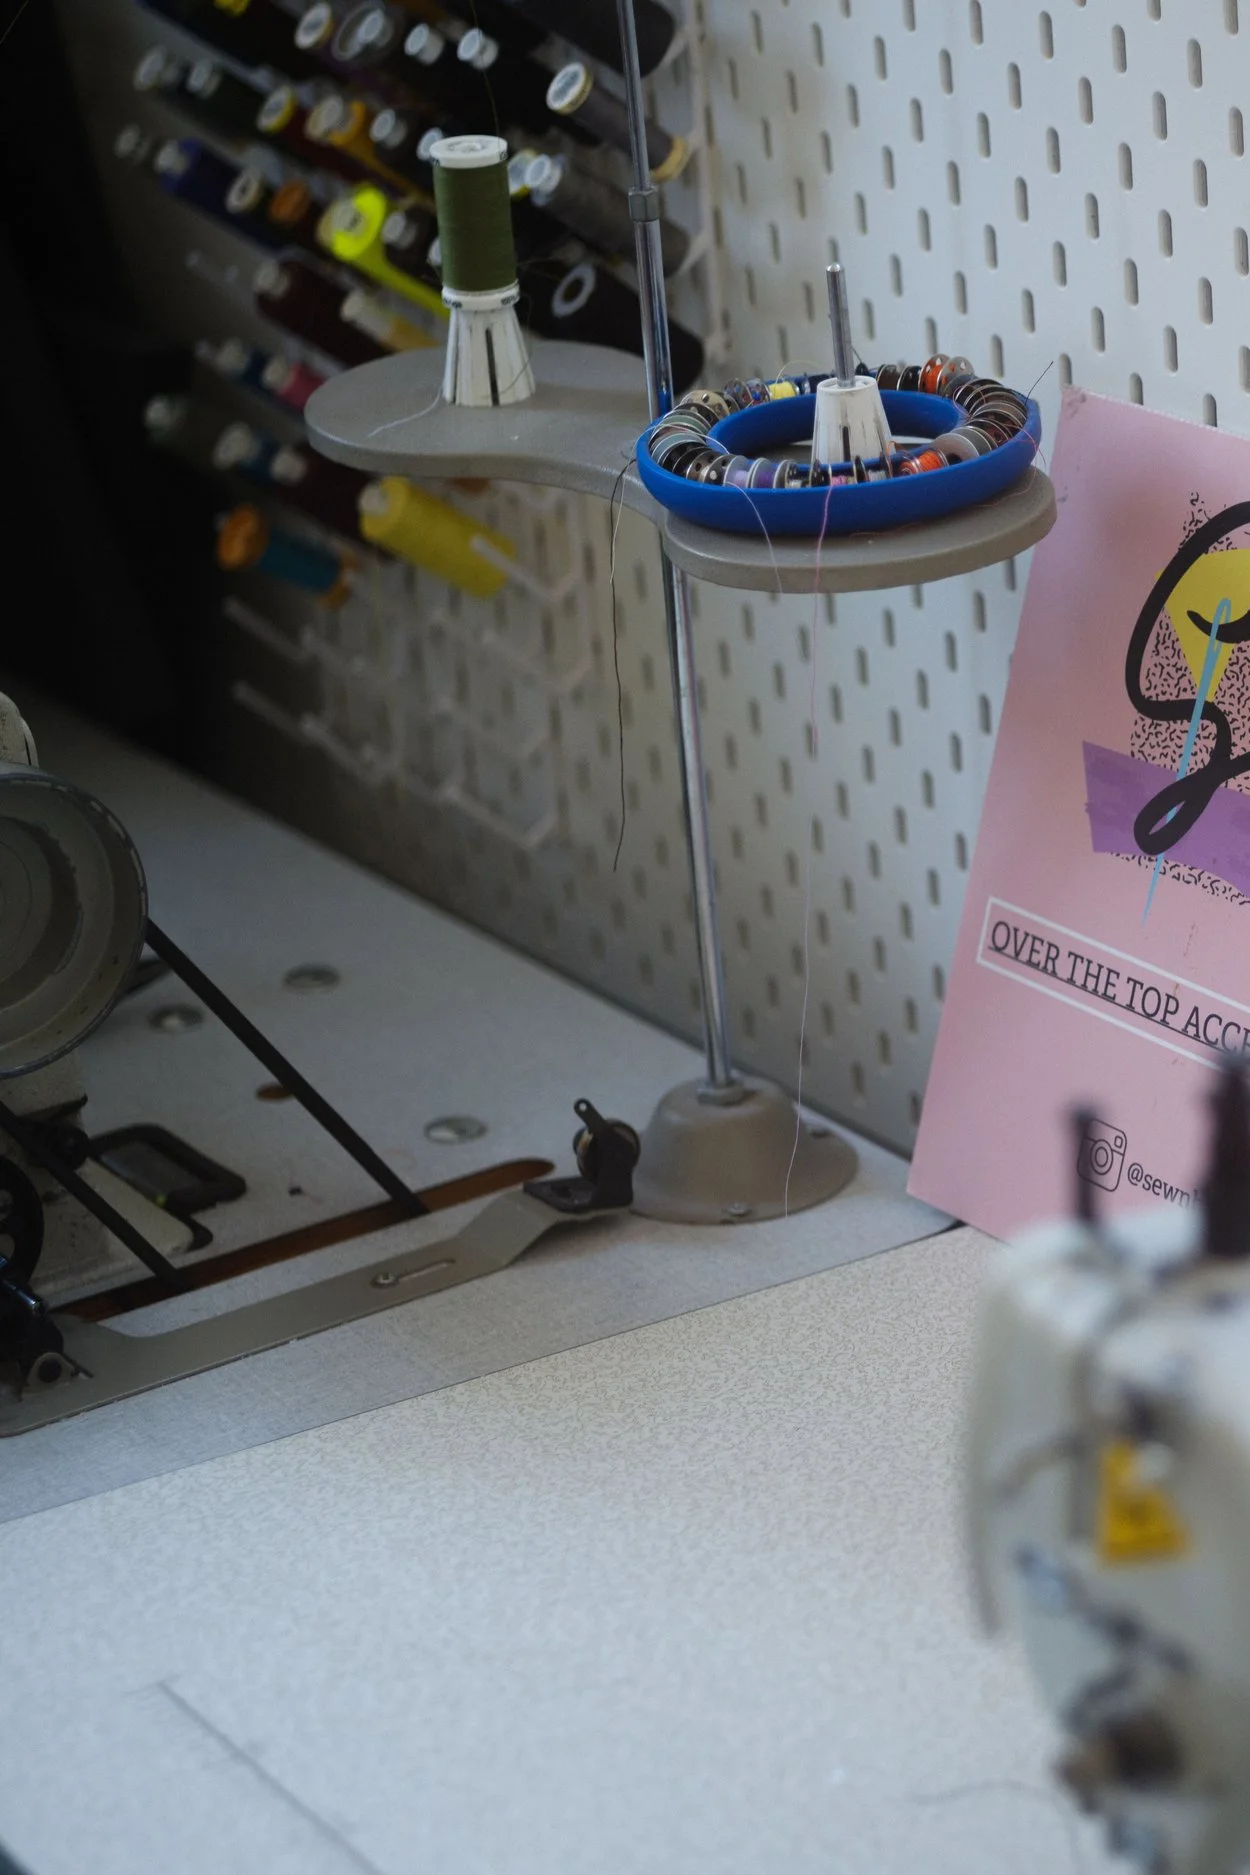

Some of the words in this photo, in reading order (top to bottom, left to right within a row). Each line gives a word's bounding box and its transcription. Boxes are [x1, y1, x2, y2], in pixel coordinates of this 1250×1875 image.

[991, 919, 1059, 978] OVER
[1067, 950, 1121, 1001] THE
[1125, 976, 1181, 1026] TOP
